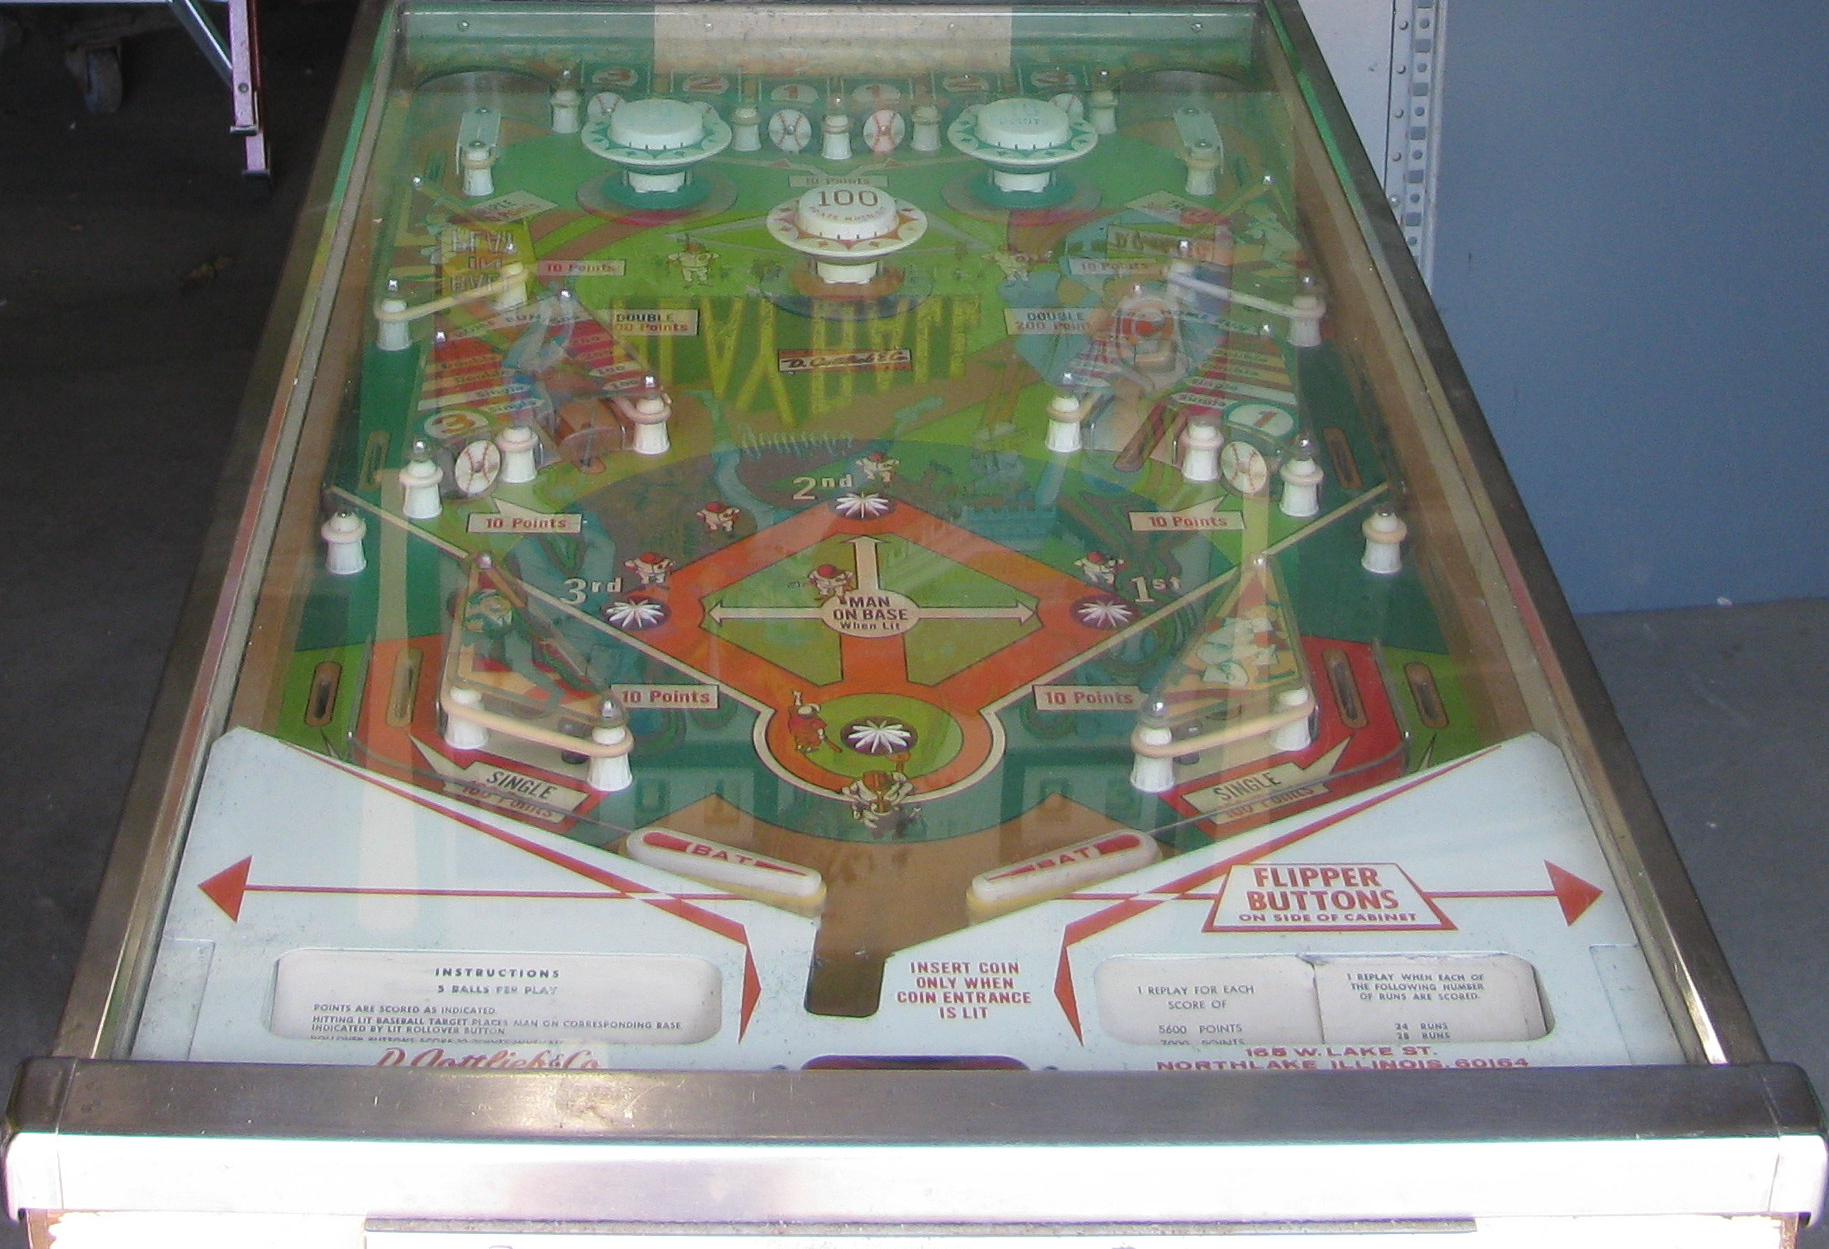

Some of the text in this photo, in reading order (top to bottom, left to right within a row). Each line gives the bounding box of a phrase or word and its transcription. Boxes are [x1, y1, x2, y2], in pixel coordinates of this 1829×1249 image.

[817, 189, 879, 208] 100
[615, 312, 675, 323] DOUBLE
[1026, 311, 1084, 322] DOUBLE
[638, 322, 689, 333] Points
[792, 474, 854, 500] 2nd
[486, 517, 568, 529] 10 Points
[1149, 516, 1228, 528] 10 Points
[558, 577, 623, 606] 3rd
[849, 596, 890, 608] MAN
[833, 608, 909, 621] ON BASE
[840, 621, 901, 631] When Lit
[621, 689, 711, 704] 10 Points
[1044, 691, 1134, 705] 10 Points
[486, 770, 558, 800] SINGLE
[1213, 772, 1282, 801] SINGLE
[692, 843, 754, 864] BAT
[1038, 846, 1092, 870] BAT
[1253, 866, 1382, 888] FLIPPER
[1246, 889, 1400, 911] BUTTONS
[1238, 912, 1417, 922] ON SIDE OF CABINET
[435, 967, 560, 979] INSTRUCTIONS
[910, 961, 1020, 974] INSERT COIN
[916, 976, 1014, 989] ONLY WHEN
[1357, 973, 1394, 981] REPLAY
[1401, 973, 1433, 981] WHEN
[1438, 973, 1465, 981] EACH
[1470, 973, 1484, 981] OF
[437, 984, 559, 995] 5 BALLS PER PLAY
[1148, 985, 1188, 995] REPLAY
[1194, 985, 1218, 995] FOR
[1223, 984, 1255, 994] EACH
[1351, 983, 1485, 991] THE FOLLOWING NUMBER
[897, 991, 1032, 1004] COIN ENTRANCE
[1359, 992, 1373, 1001] OF
[1379, 993, 1407, 1001] RUNS
[1413, 993, 1432, 1001] ARE
[313, 1003, 351, 1013] POINTS
[355, 1004, 376, 1013] ARE
[379, 1005, 420, 1014] SCORED
[423, 1005, 437, 1014] AS
[1168, 1000, 1228, 1010] SCORE OF
[939, 1006, 988, 1019] IS LIT
[312, 1015, 354, 1024] HITTING
[357, 1016, 372, 1024] LIT
[376, 1016, 425, 1025] BASEBALL
[429, 1017, 467, 1026] TARGET
[471, 1018, 508, 1027] PLACES
[513, 1019, 538, 1027] MAN
[543, 1019, 559, 1028] ON
[563, 1020, 652, 1030] CORRESPONDING
[1158, 1023, 1243, 1034] 5600 POINTS
[1420, 1022, 1448, 1031] RUNS
[311, 1024, 366, 1033] INDICATED
[370, 1024, 383, 1033] BY
[387, 1025, 401, 1033] LIT
[406, 1025, 459, 1035] ROLLOVER
[1422, 1031, 1450, 1040] RUNS
[1293, 1048, 1322, 1057] W.
[1326, 1046, 1393, 1057] LAKE
[1401, 1045, 1438, 1056] ST.
[1156, 1059, 1319, 1070] NORTHLAKE
